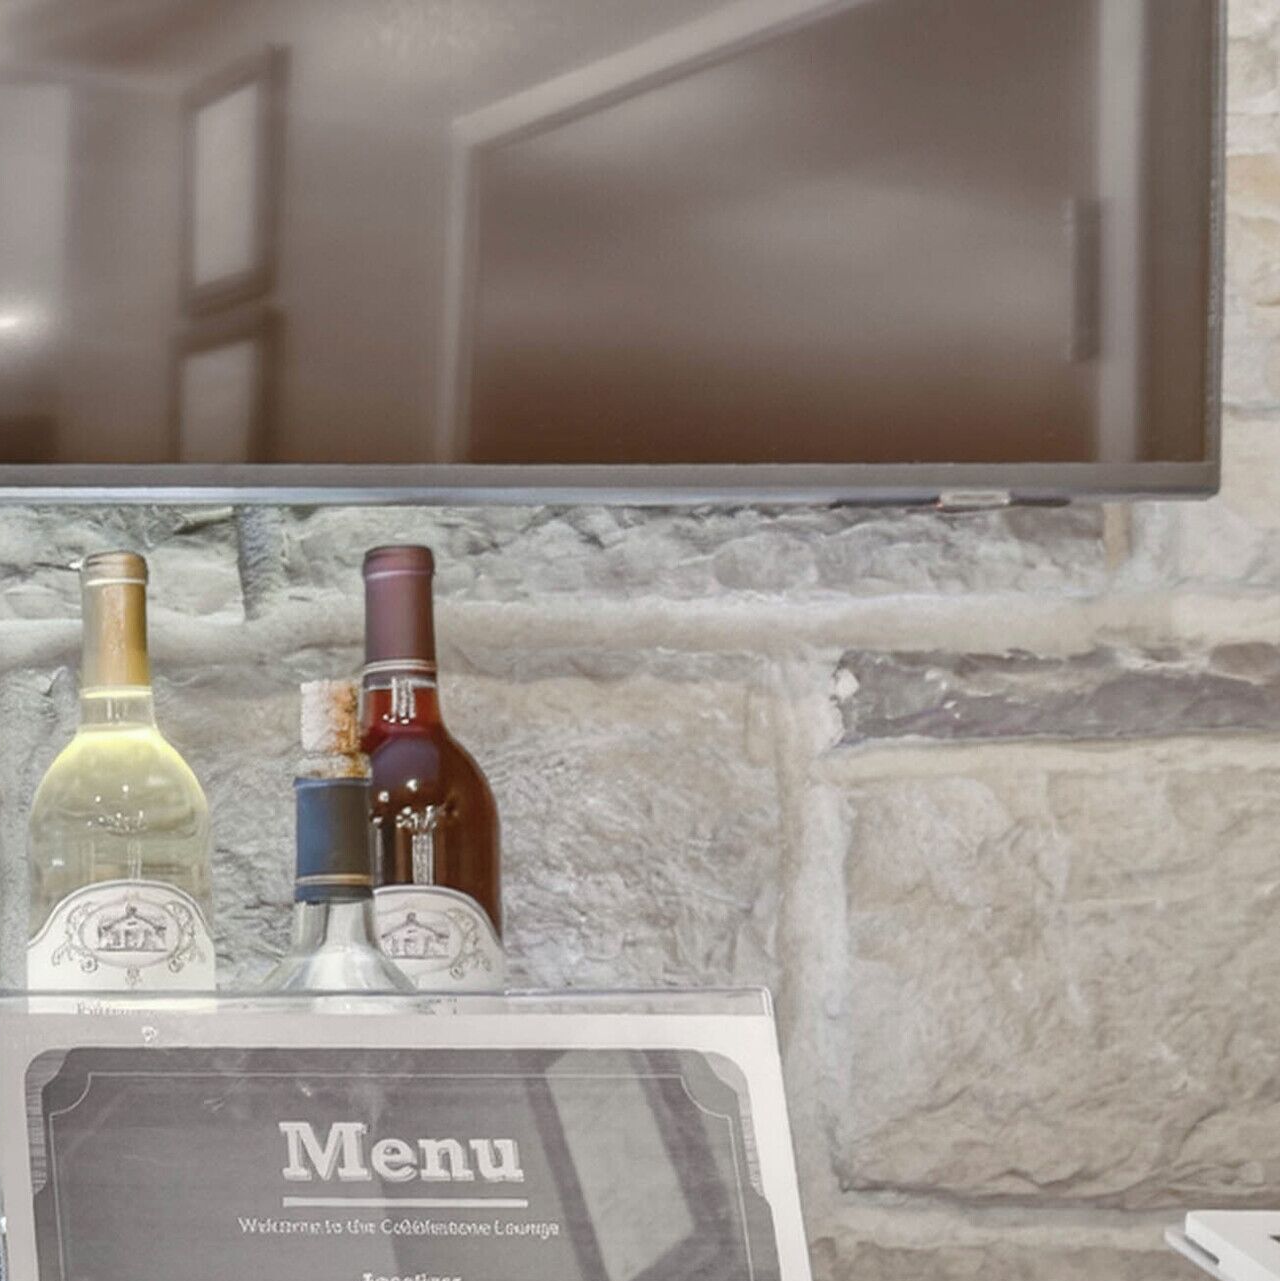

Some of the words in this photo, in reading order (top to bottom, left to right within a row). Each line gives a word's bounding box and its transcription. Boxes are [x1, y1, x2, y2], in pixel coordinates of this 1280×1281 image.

[279, 1122, 525, 1182] Menu
[238, 1217, 321, 1235] Welcome
[325, 1219, 342, 1234] to
[345, 1219, 375, 1235] the
[494, 1219, 560, 1239] Lounge
